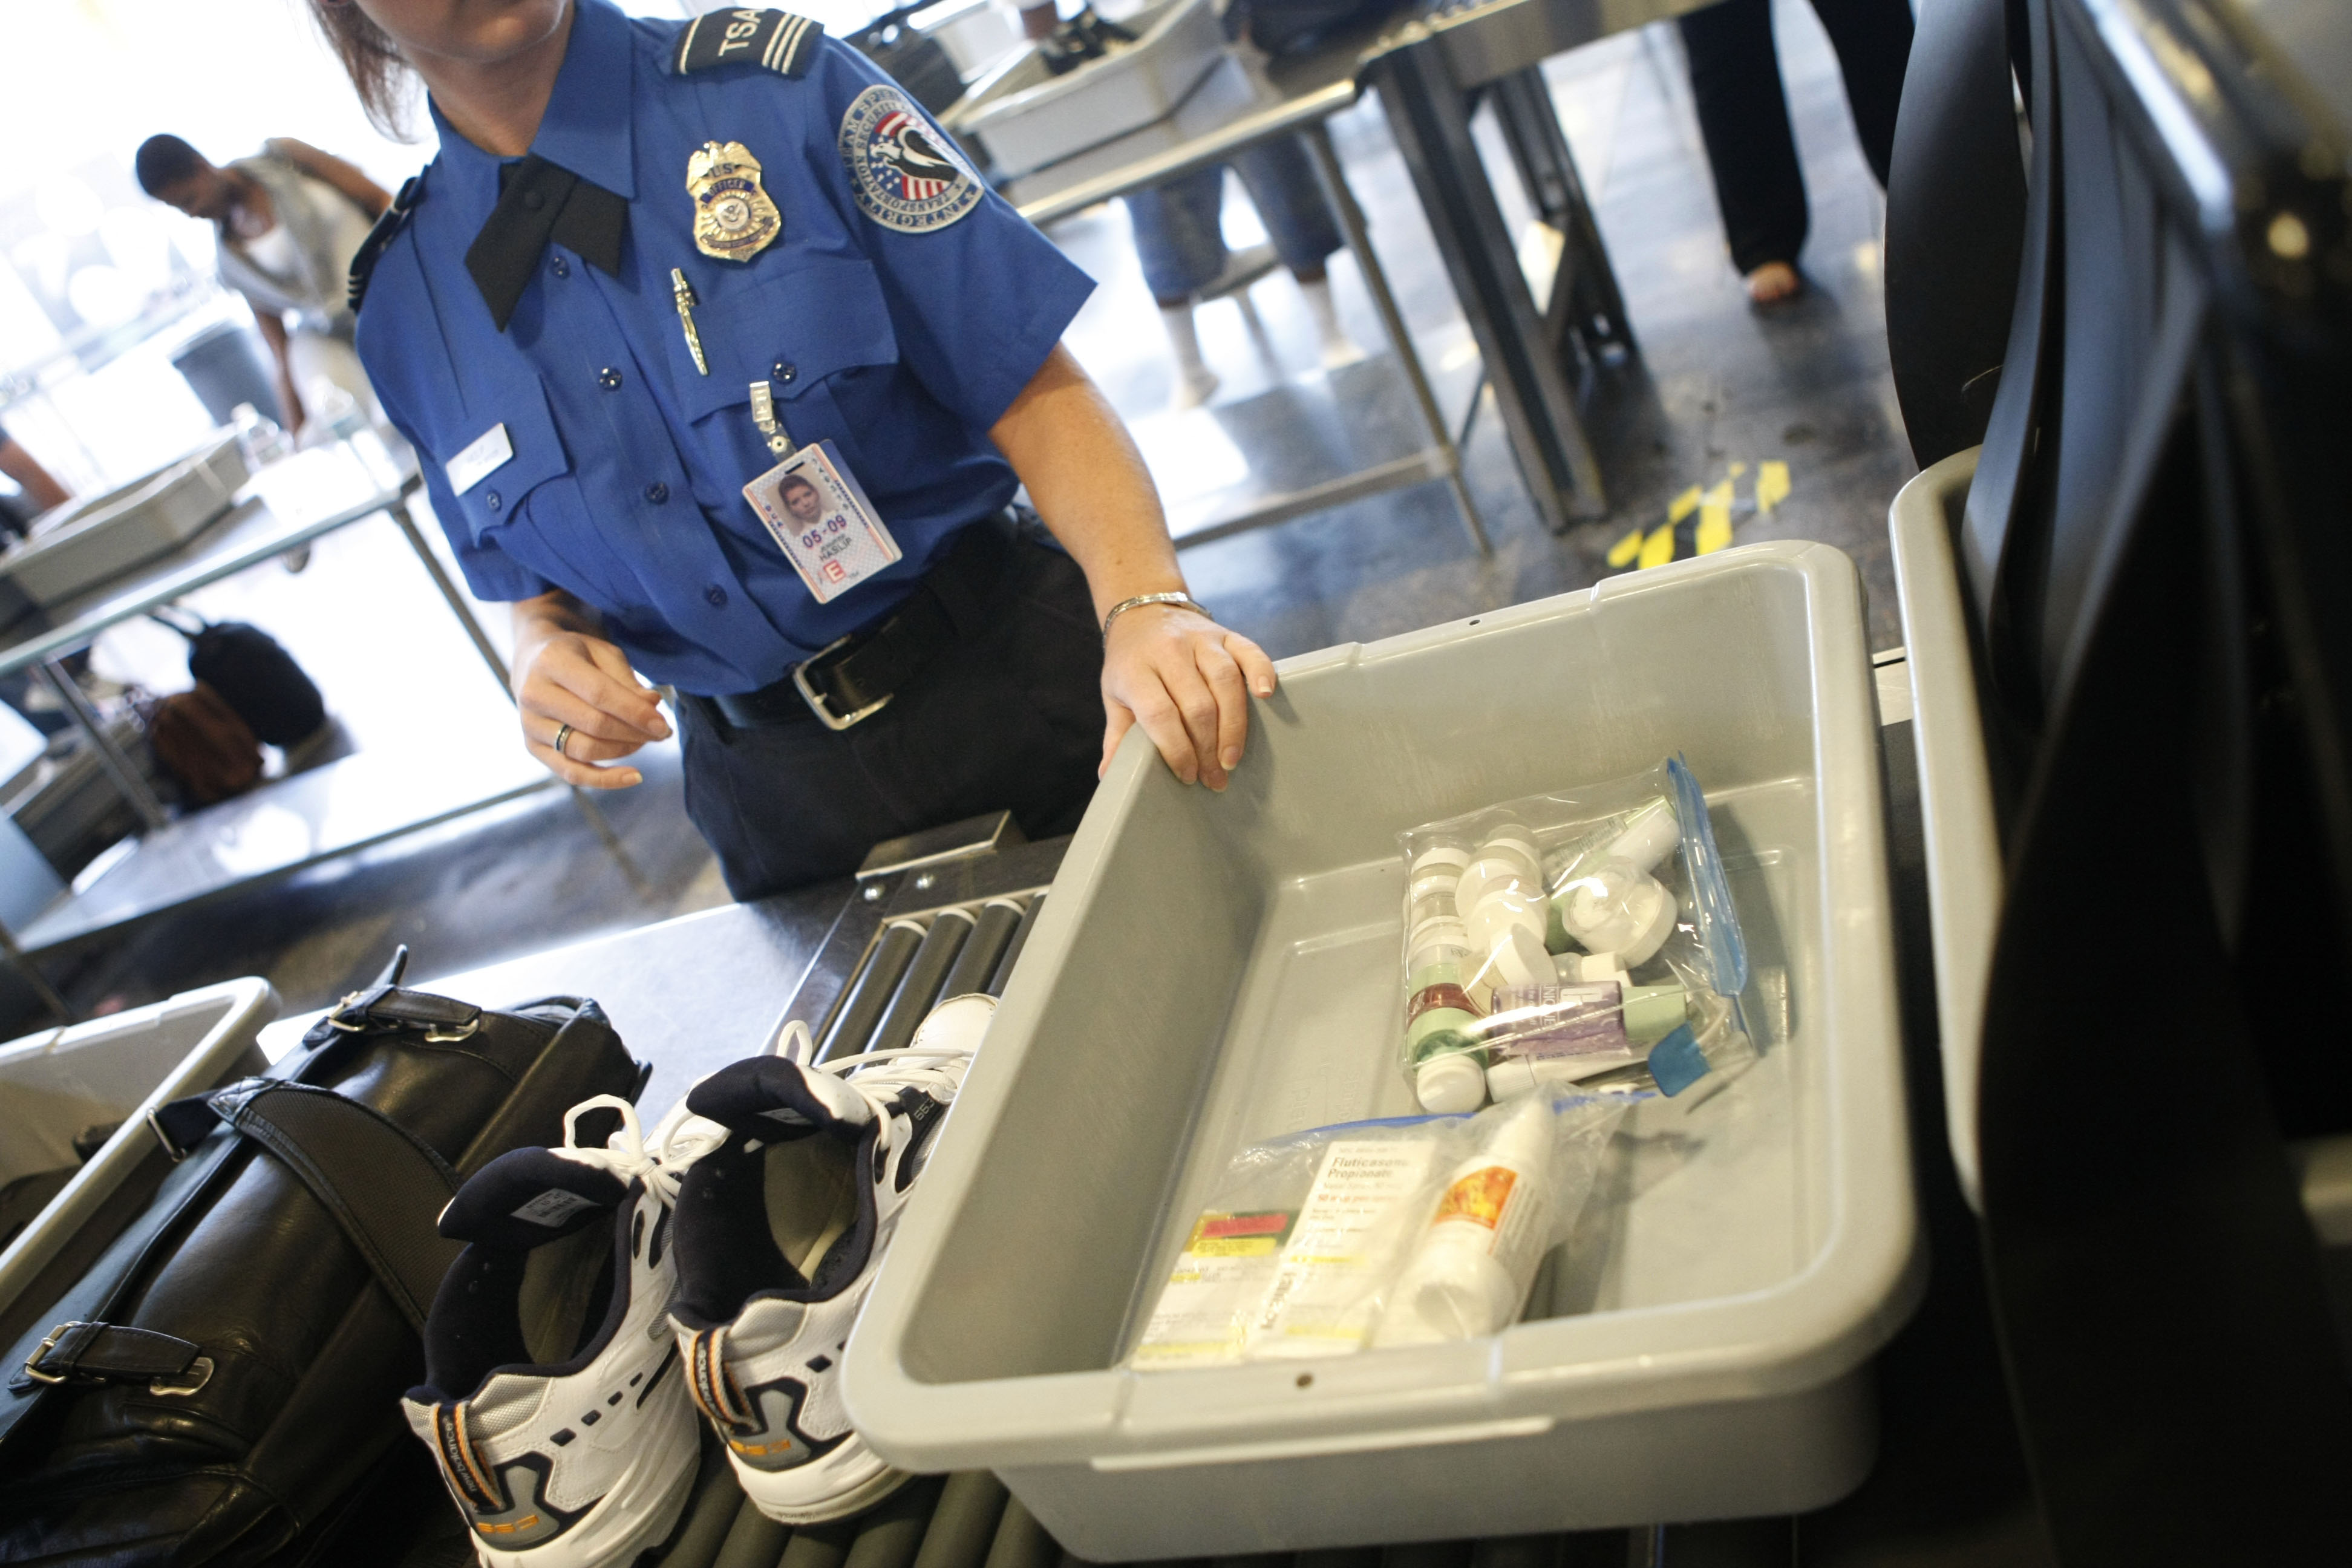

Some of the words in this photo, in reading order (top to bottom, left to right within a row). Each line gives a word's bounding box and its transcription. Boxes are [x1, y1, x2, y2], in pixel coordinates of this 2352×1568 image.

[718, 8, 766, 56] TSA
[712, 163, 734, 178] US
[856, 155, 952, 212] TRANSPORTATION
[855, 192, 969, 228] INTEGRITY
[802, 514, 847, 549] 05-09
[825, 561, 845, 581] E
